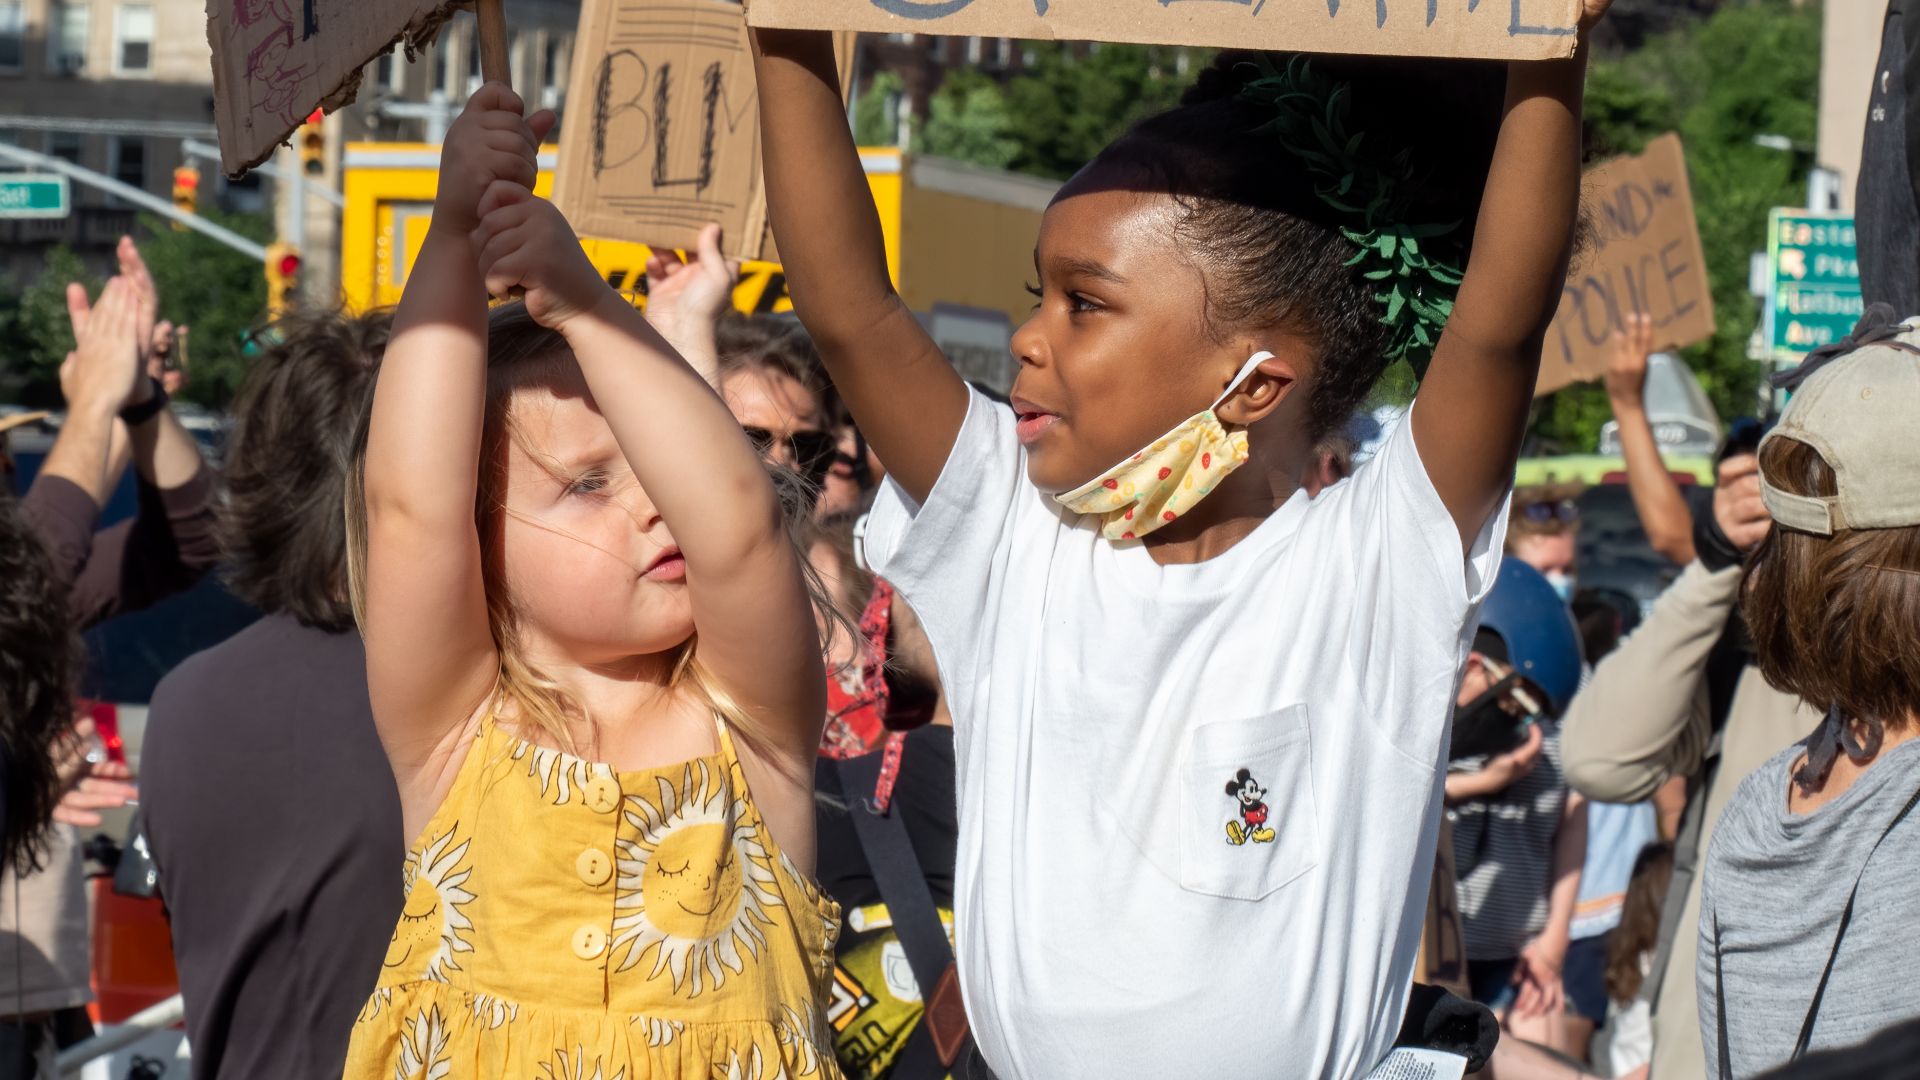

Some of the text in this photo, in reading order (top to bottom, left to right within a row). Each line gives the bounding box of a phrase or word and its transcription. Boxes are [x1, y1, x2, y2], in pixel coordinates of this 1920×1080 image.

[592, 48, 760, 196] BLM
[1779, 220, 1856, 247] Easte
[1553, 237, 1698, 364] POLICE
[1785, 321, 1833, 346] Ave
